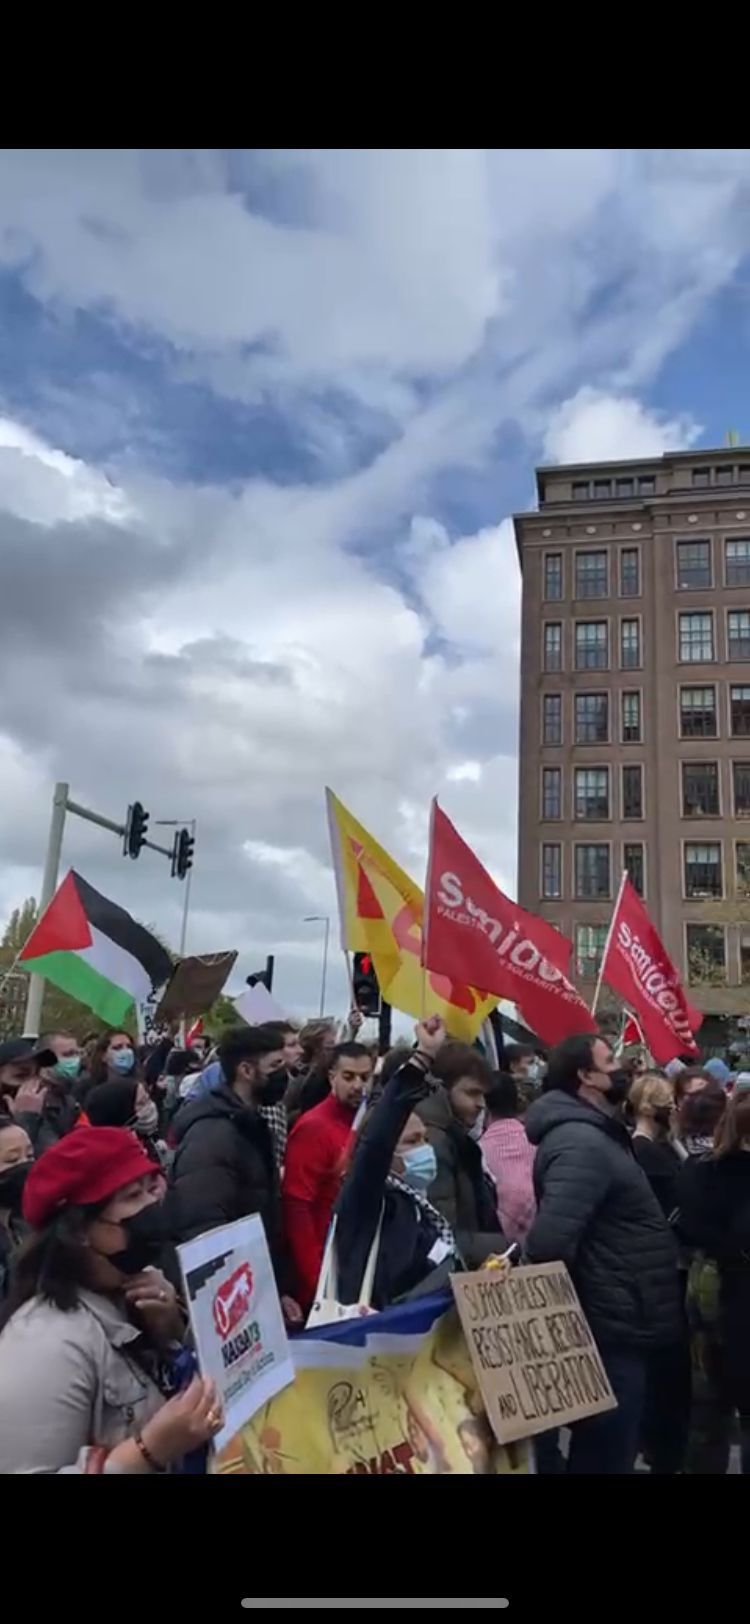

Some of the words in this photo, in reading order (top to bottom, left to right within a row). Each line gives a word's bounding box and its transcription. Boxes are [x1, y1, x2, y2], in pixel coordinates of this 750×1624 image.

[463, 1279, 513, 1321] SUPPORT
[507, 1272, 578, 1312] PALESTINIAN
[498, 1393, 518, 1420] AND
[508, 1352, 611, 1421] LIBERATION
